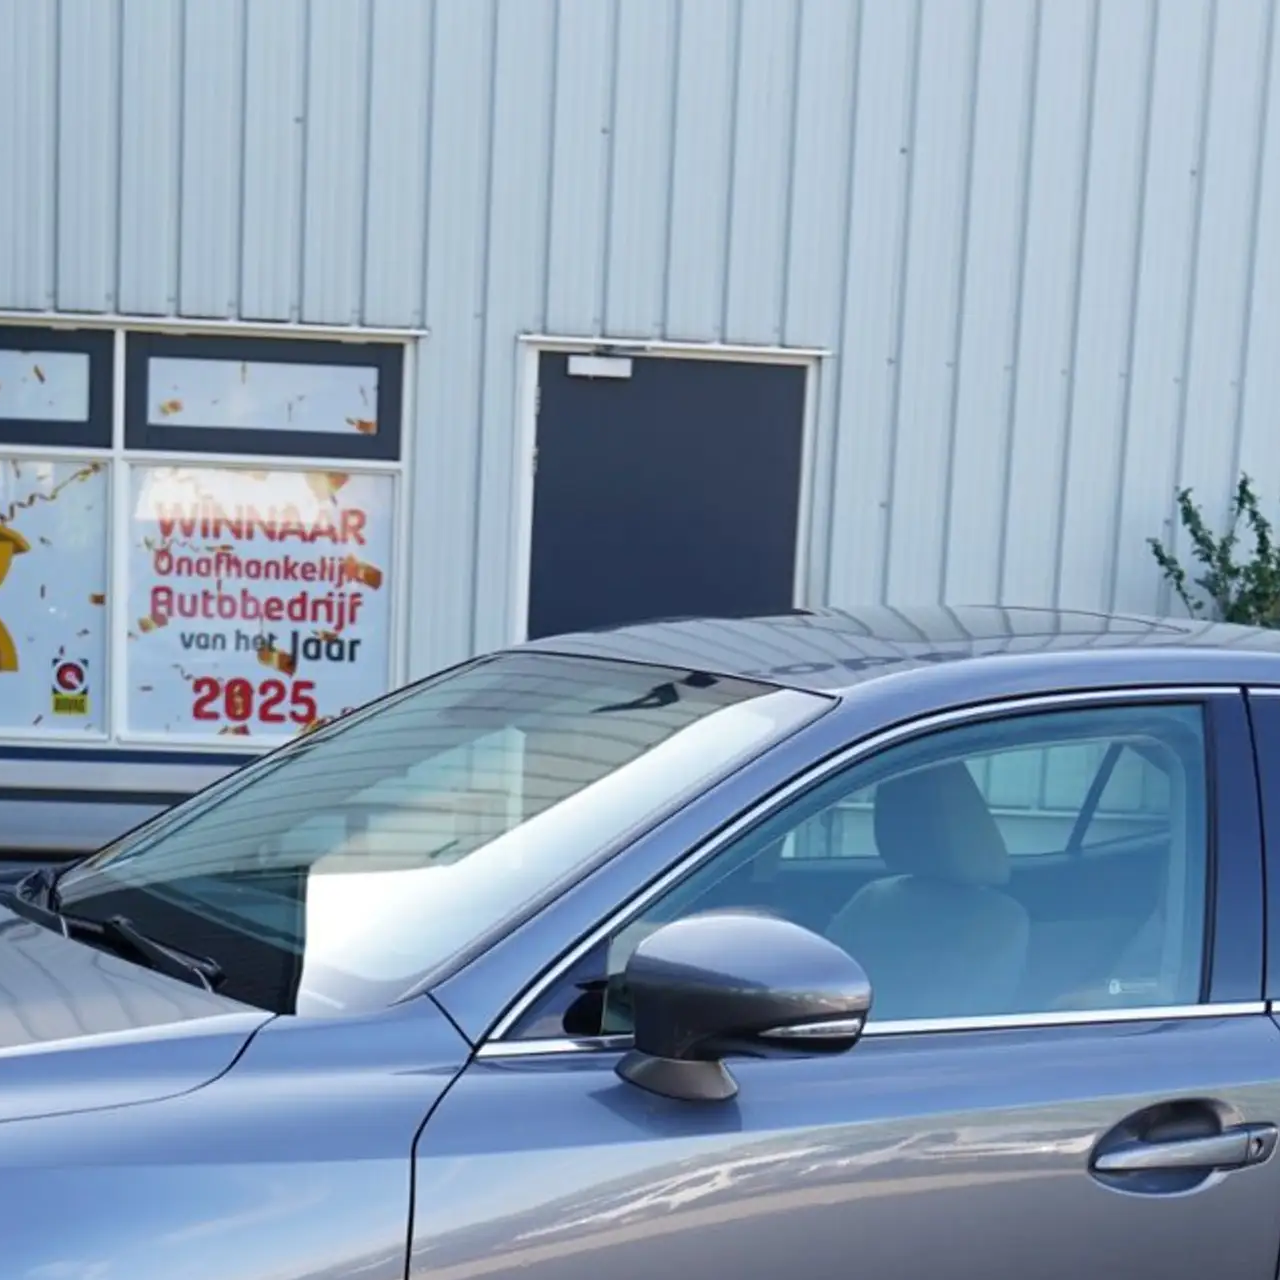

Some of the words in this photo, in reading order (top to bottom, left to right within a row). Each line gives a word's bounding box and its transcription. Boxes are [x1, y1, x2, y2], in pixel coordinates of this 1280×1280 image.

[155, 502, 367, 546] WINNAAR
[150, 585, 364, 633] Autobedrijf
[179, 631, 227, 651] van
[234, 629, 278, 652] het
[284, 629, 362, 668] Jaar
[191, 676, 318, 724] 2025
